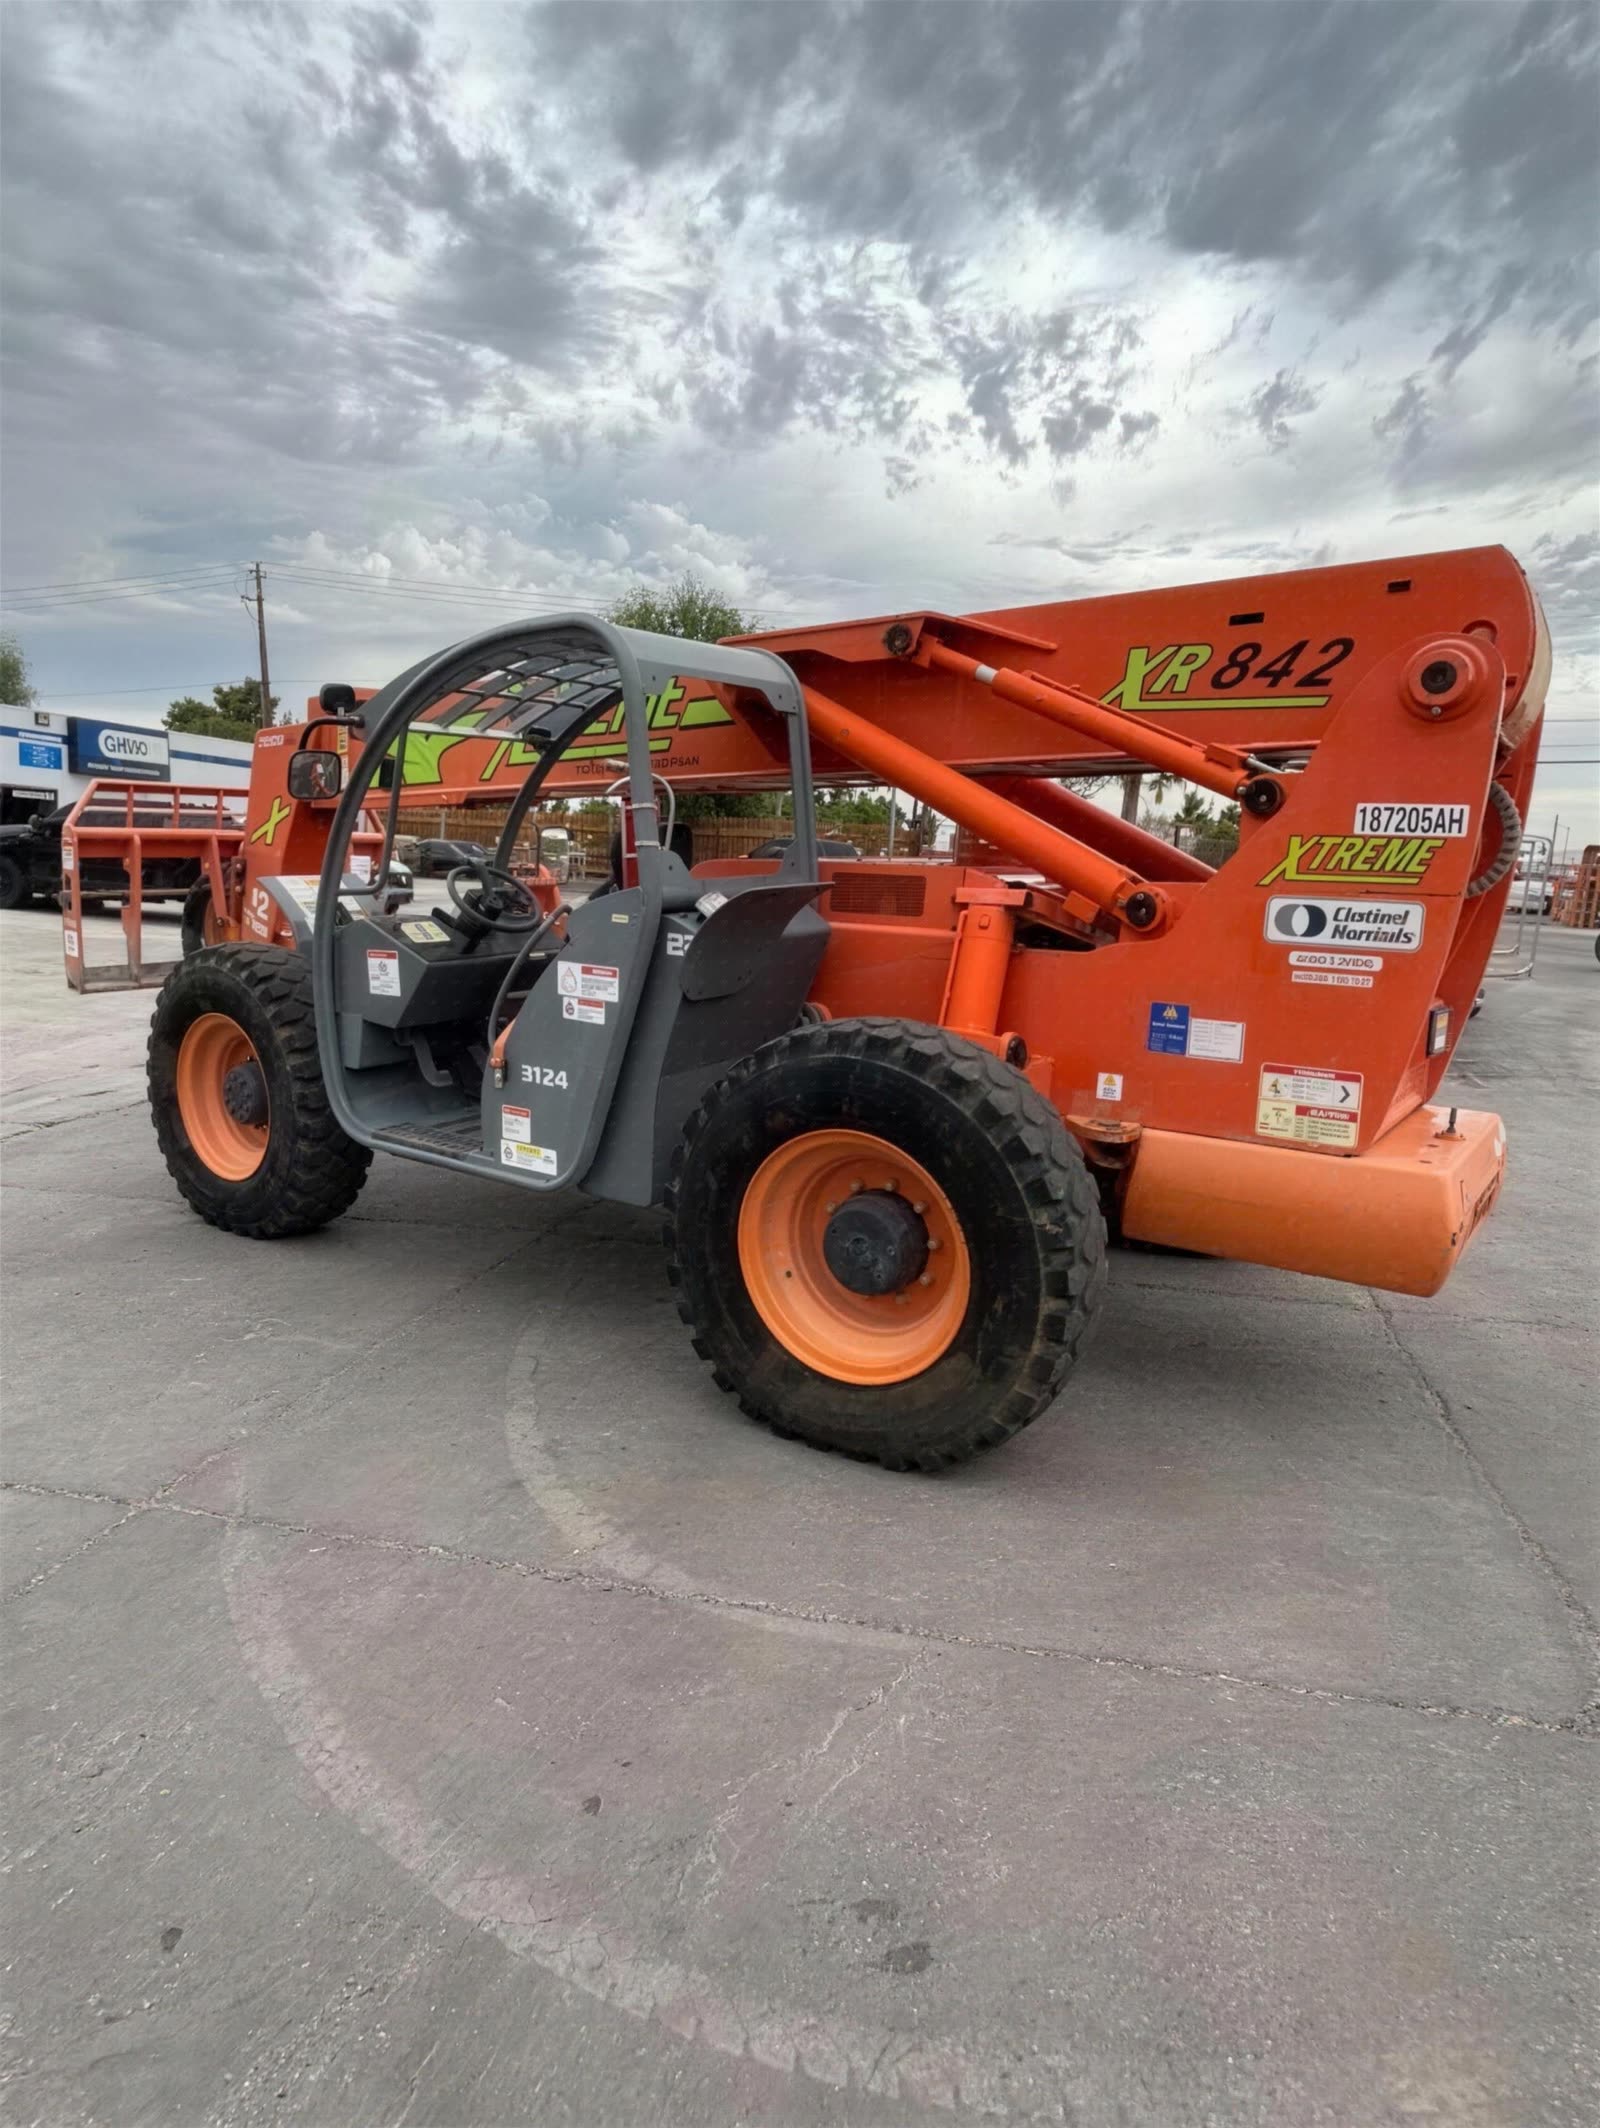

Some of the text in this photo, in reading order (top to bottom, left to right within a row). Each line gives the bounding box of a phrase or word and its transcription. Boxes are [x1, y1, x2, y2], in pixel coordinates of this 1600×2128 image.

[1210, 637, 1355, 690] 842
[1359, 806, 1465, 834] 187205AH
[1255, 835, 1447, 887] XTREME
[521, 1064, 568, 1090] 3124
